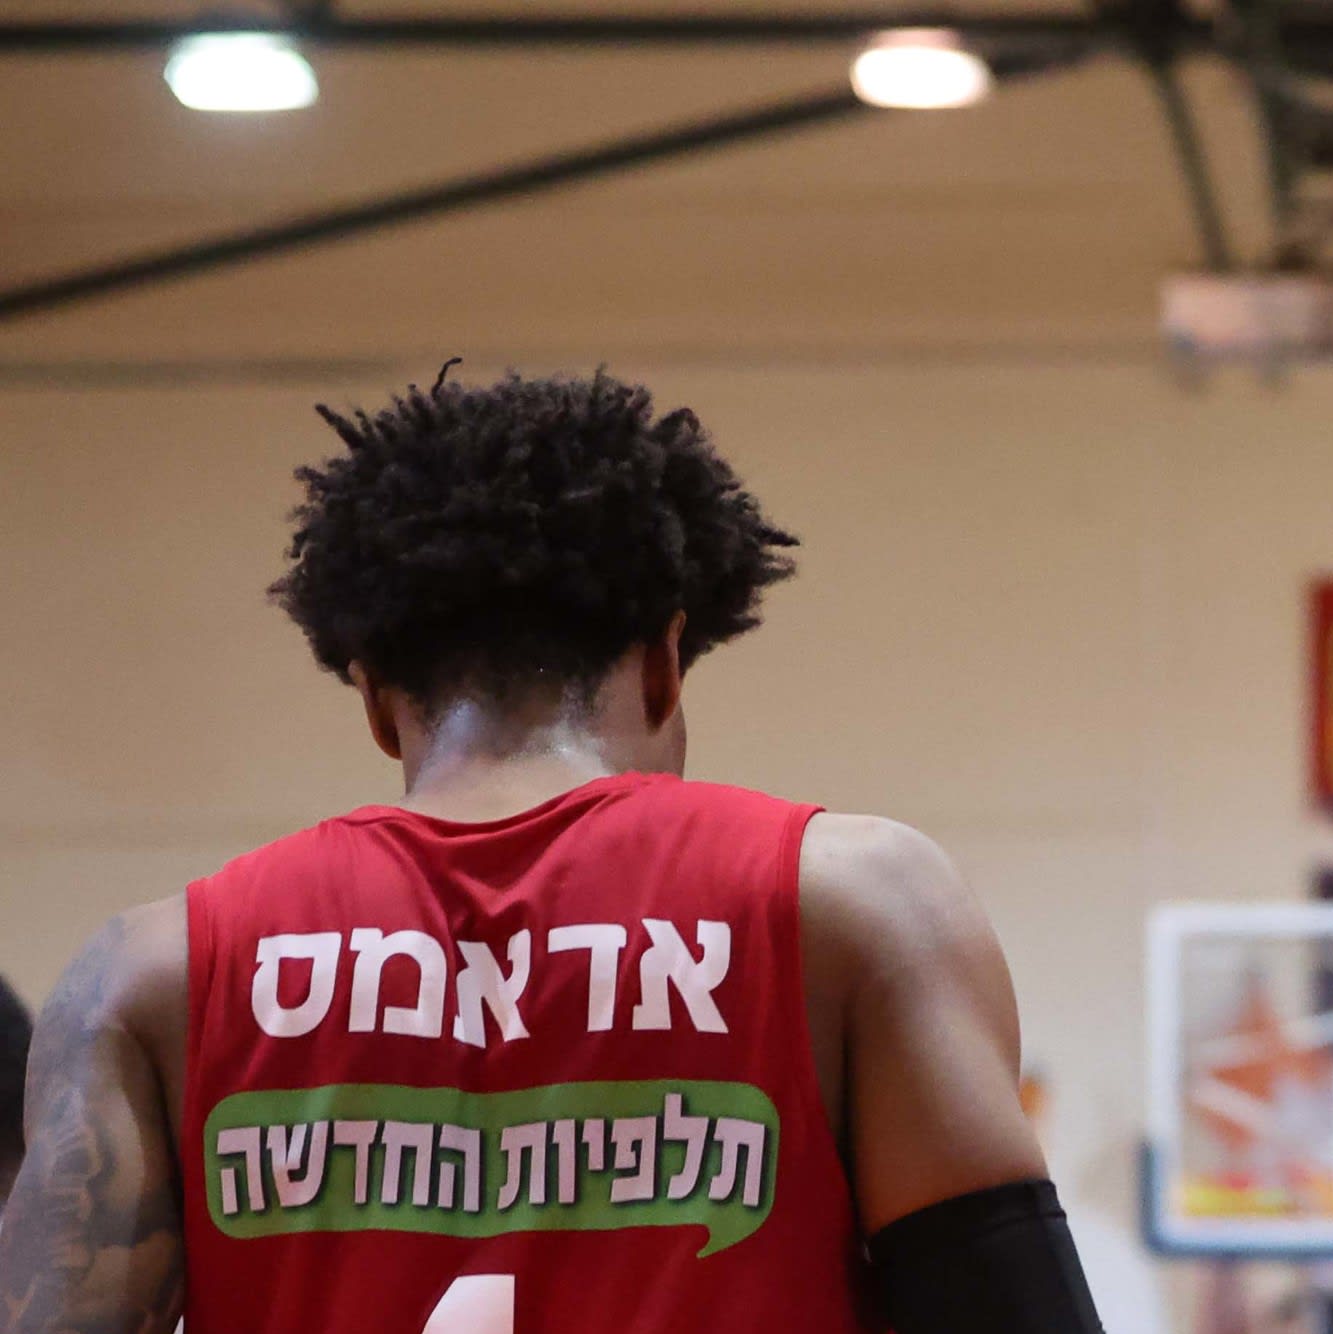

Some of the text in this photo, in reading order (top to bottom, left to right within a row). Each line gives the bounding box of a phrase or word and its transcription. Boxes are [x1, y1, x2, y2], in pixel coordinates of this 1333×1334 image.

[250, 917, 732, 1049] אדאמס
[216, 1092, 766, 1216] תלפיות החדשה
